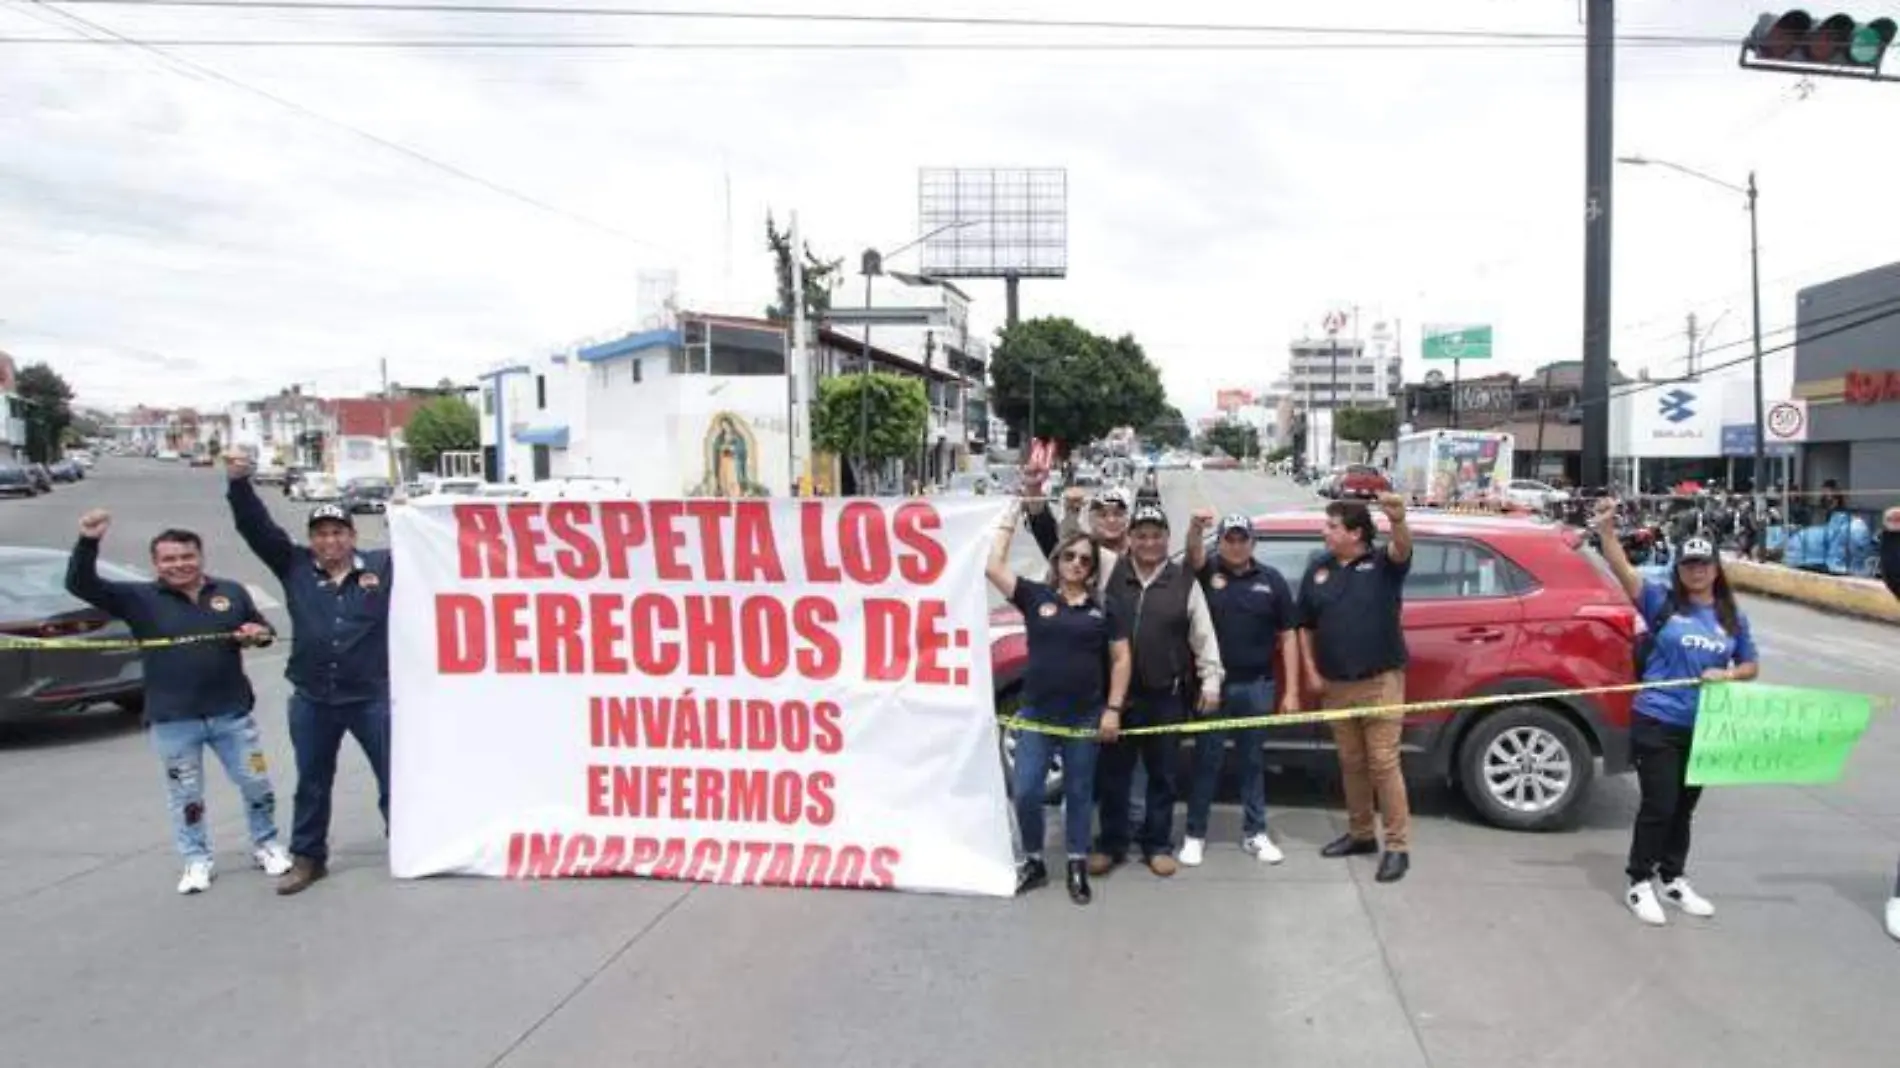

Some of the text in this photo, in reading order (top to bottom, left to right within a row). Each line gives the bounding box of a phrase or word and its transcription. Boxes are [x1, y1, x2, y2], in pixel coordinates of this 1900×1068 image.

[455, 499, 949, 586] RESPETA LOS
[435, 592, 970, 686] DERECHOS DE:
[589, 689, 844, 754] INVÁLIDOS
[587, 765, 834, 825] ENFERMOS
[507, 832, 901, 888] INCAPACITADOS
